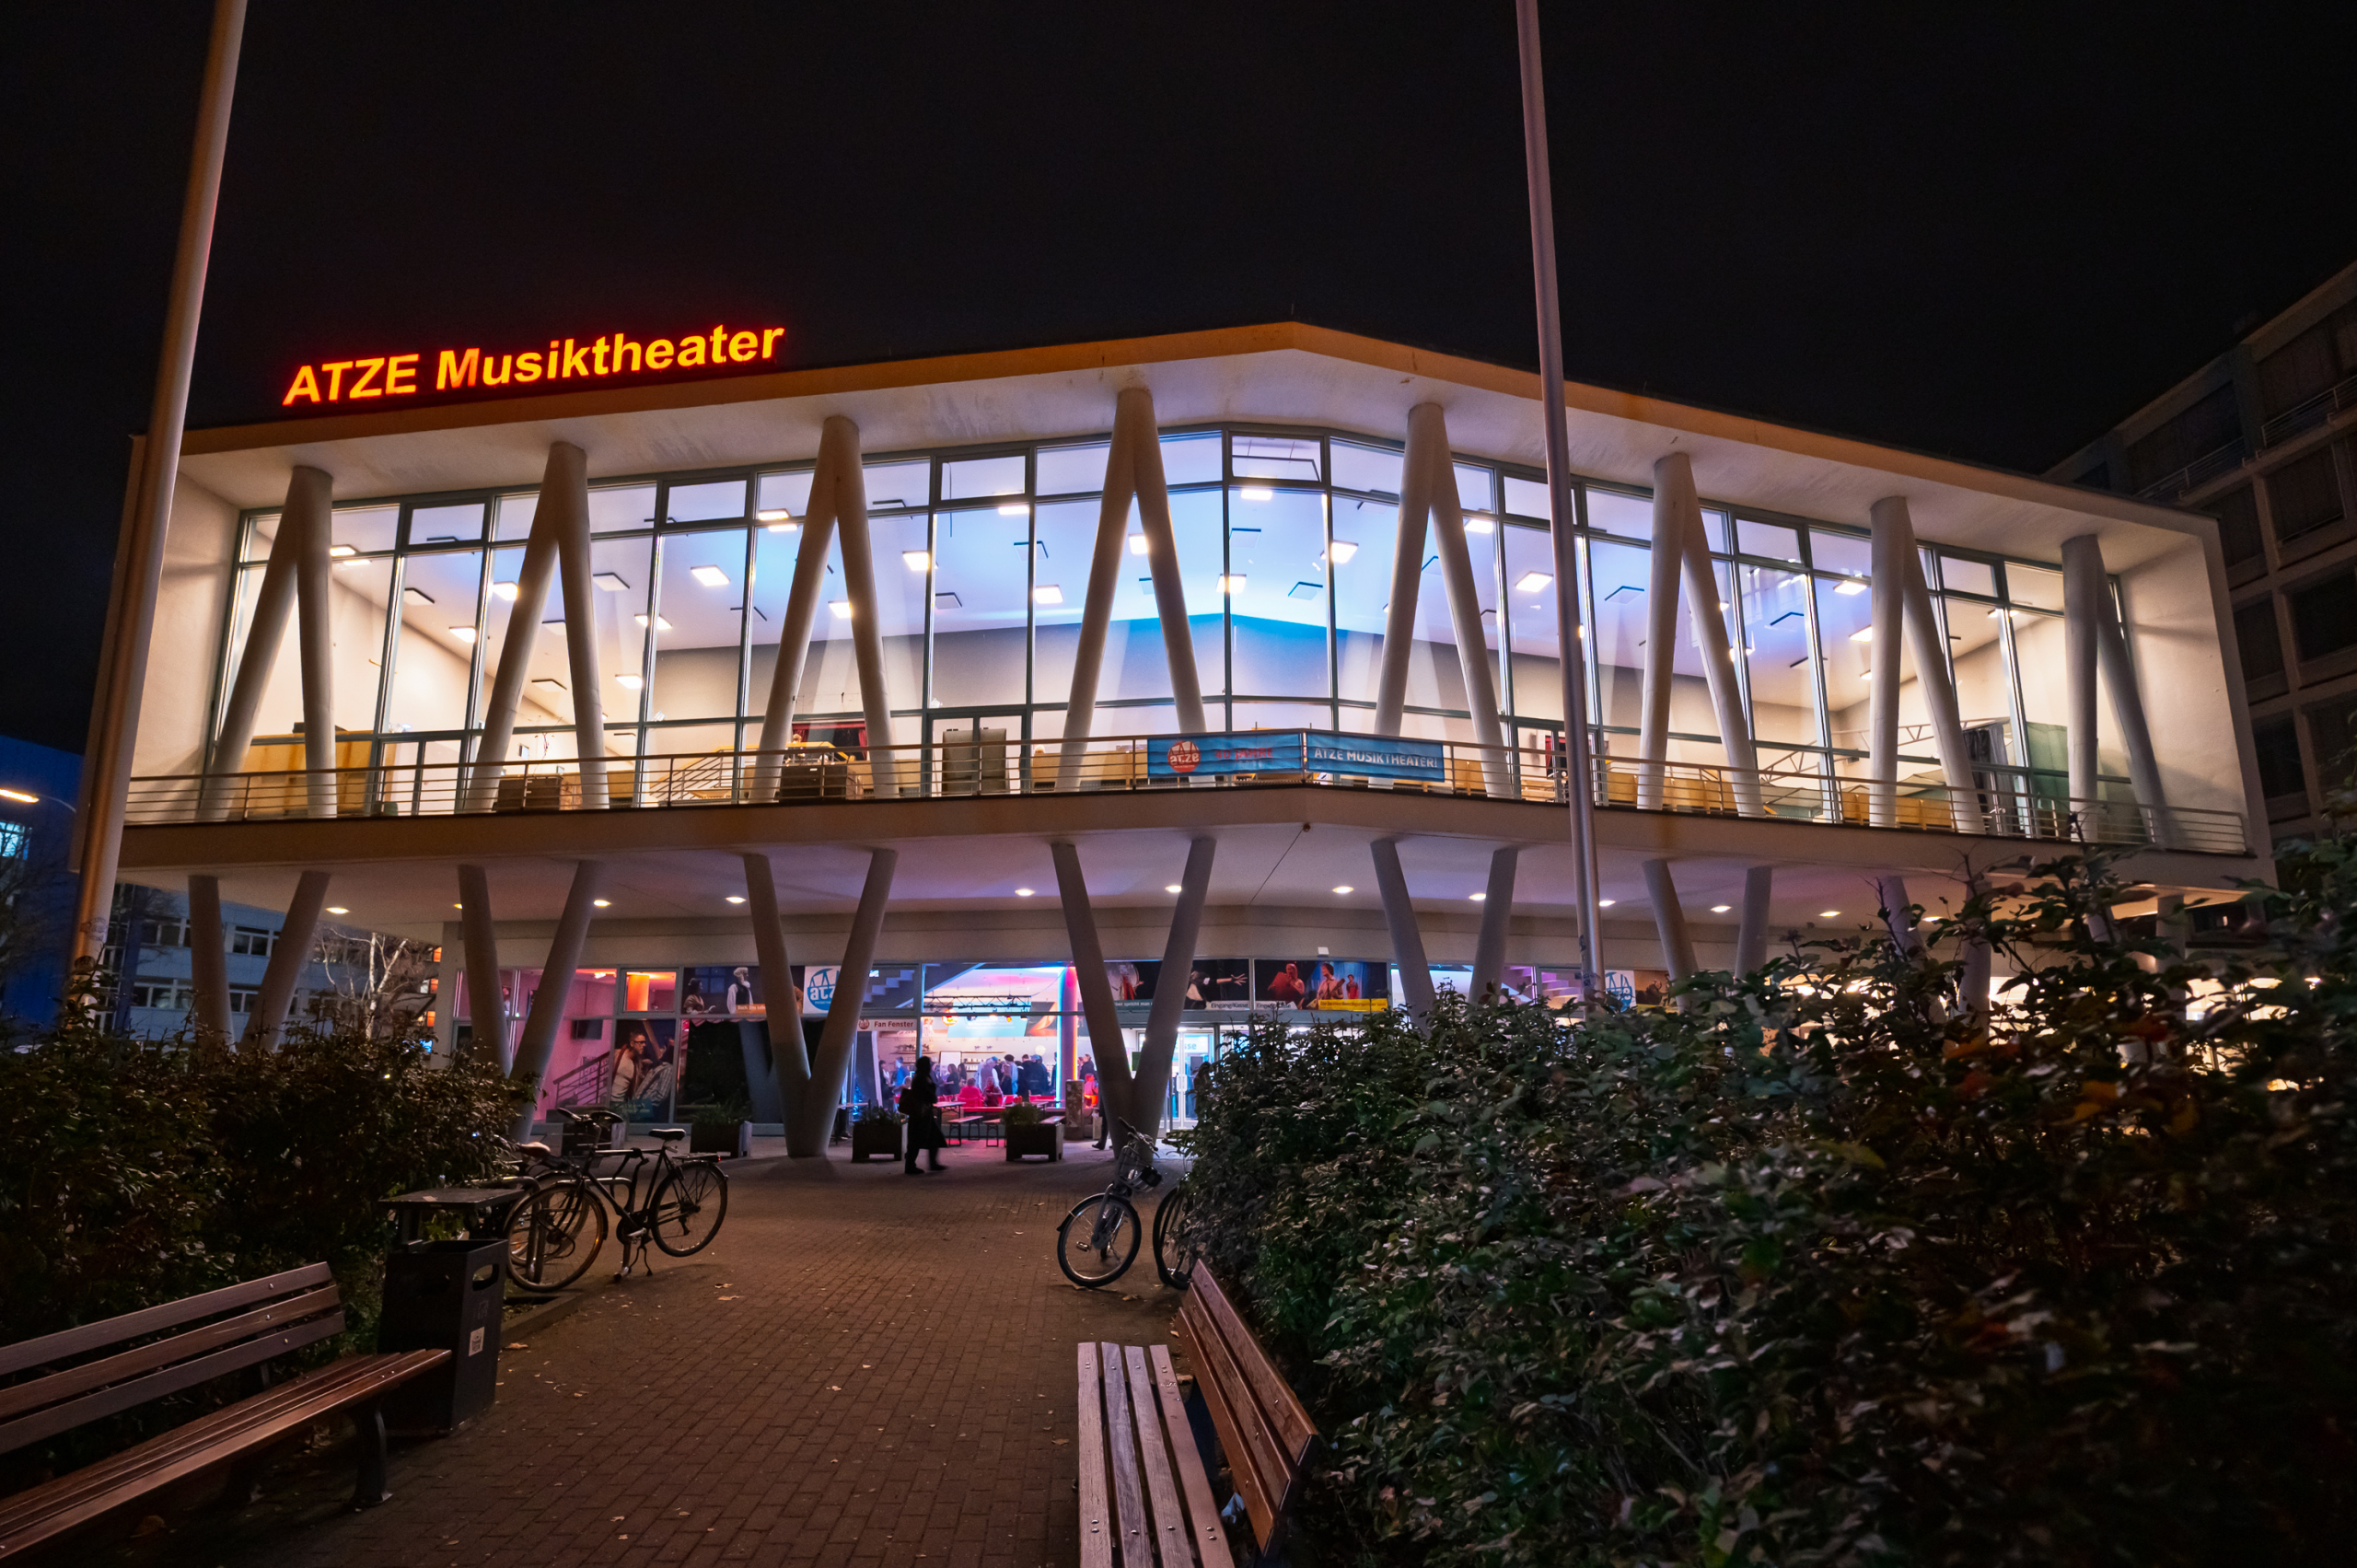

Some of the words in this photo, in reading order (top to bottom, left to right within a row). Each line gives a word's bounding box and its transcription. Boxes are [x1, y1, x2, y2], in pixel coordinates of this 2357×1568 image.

[282, 354, 420, 406] ATZE
[435, 325, 785, 389] Musiktheater
[1214, 749, 1231, 759] 40
[1235, 748, 1273, 760] JAHRE
[1314, 748, 1343, 760] ATZE
[1346, 750, 1437, 768] MUSIKTHEATER!
[810, 986, 836, 1001] atz
[1211, 1002, 1248, 1010] Eingang/Kasse
[874, 1020, 887, 1028] Fan
[888, 1020, 914, 1028] Fenster
